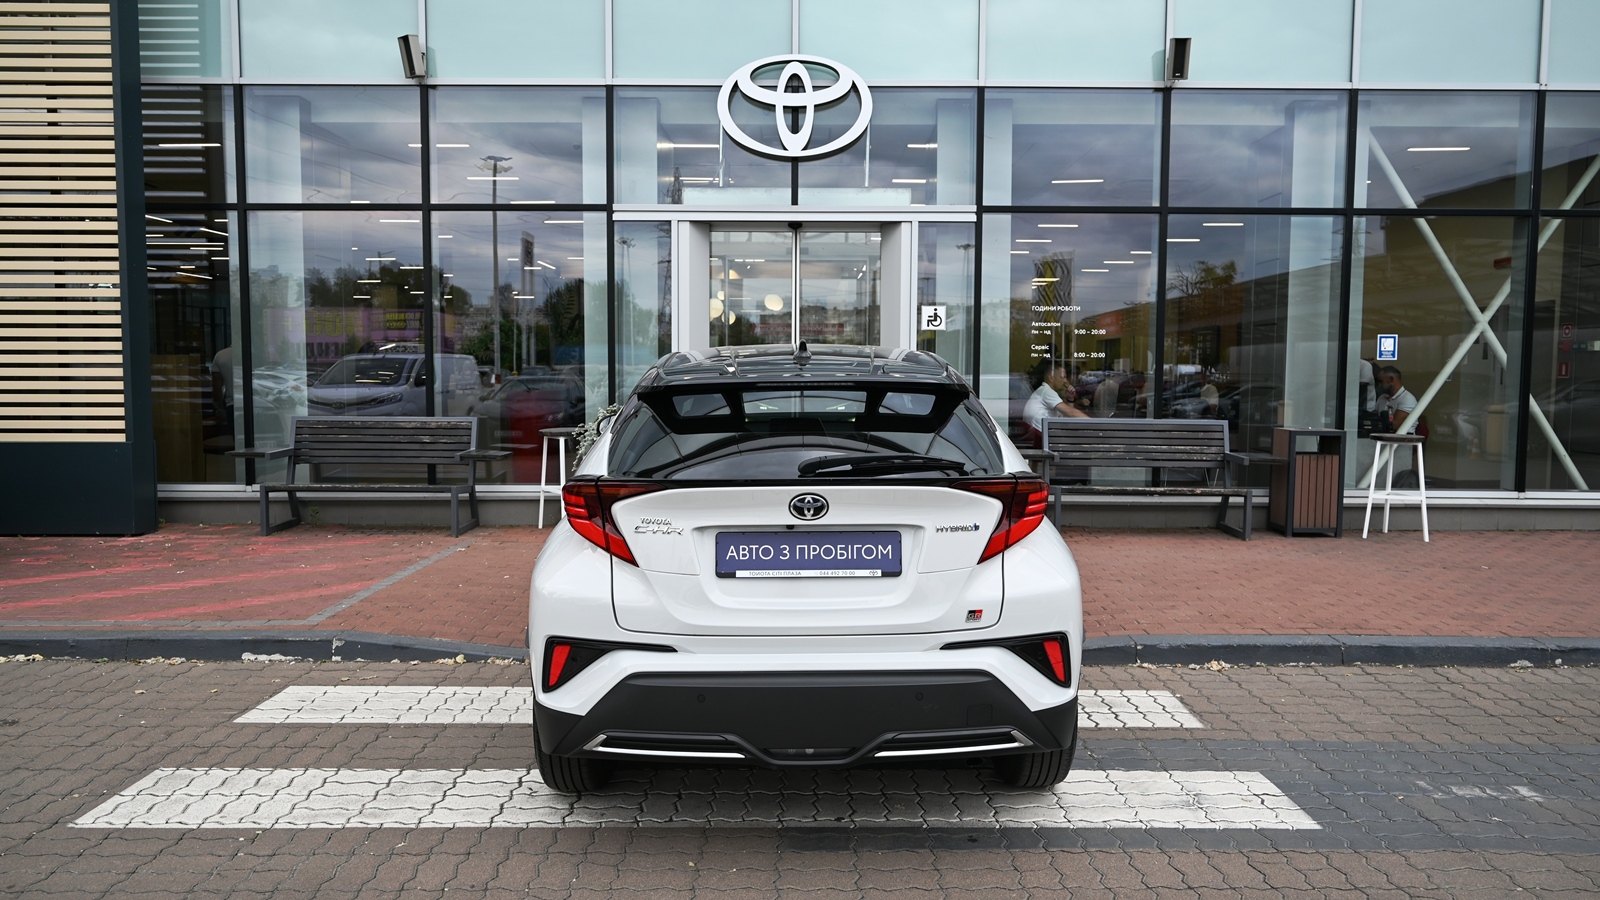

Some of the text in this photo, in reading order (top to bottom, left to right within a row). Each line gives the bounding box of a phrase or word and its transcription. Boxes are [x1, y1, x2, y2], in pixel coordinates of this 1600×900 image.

[640, 516, 672, 526] TOYOTA
[634, 525, 684, 536] C-HR
[935, 524, 974, 533] HYBRID
[726, 544, 774, 560] АВТО
[796, 544, 892, 560] ПРОБІГОМ
